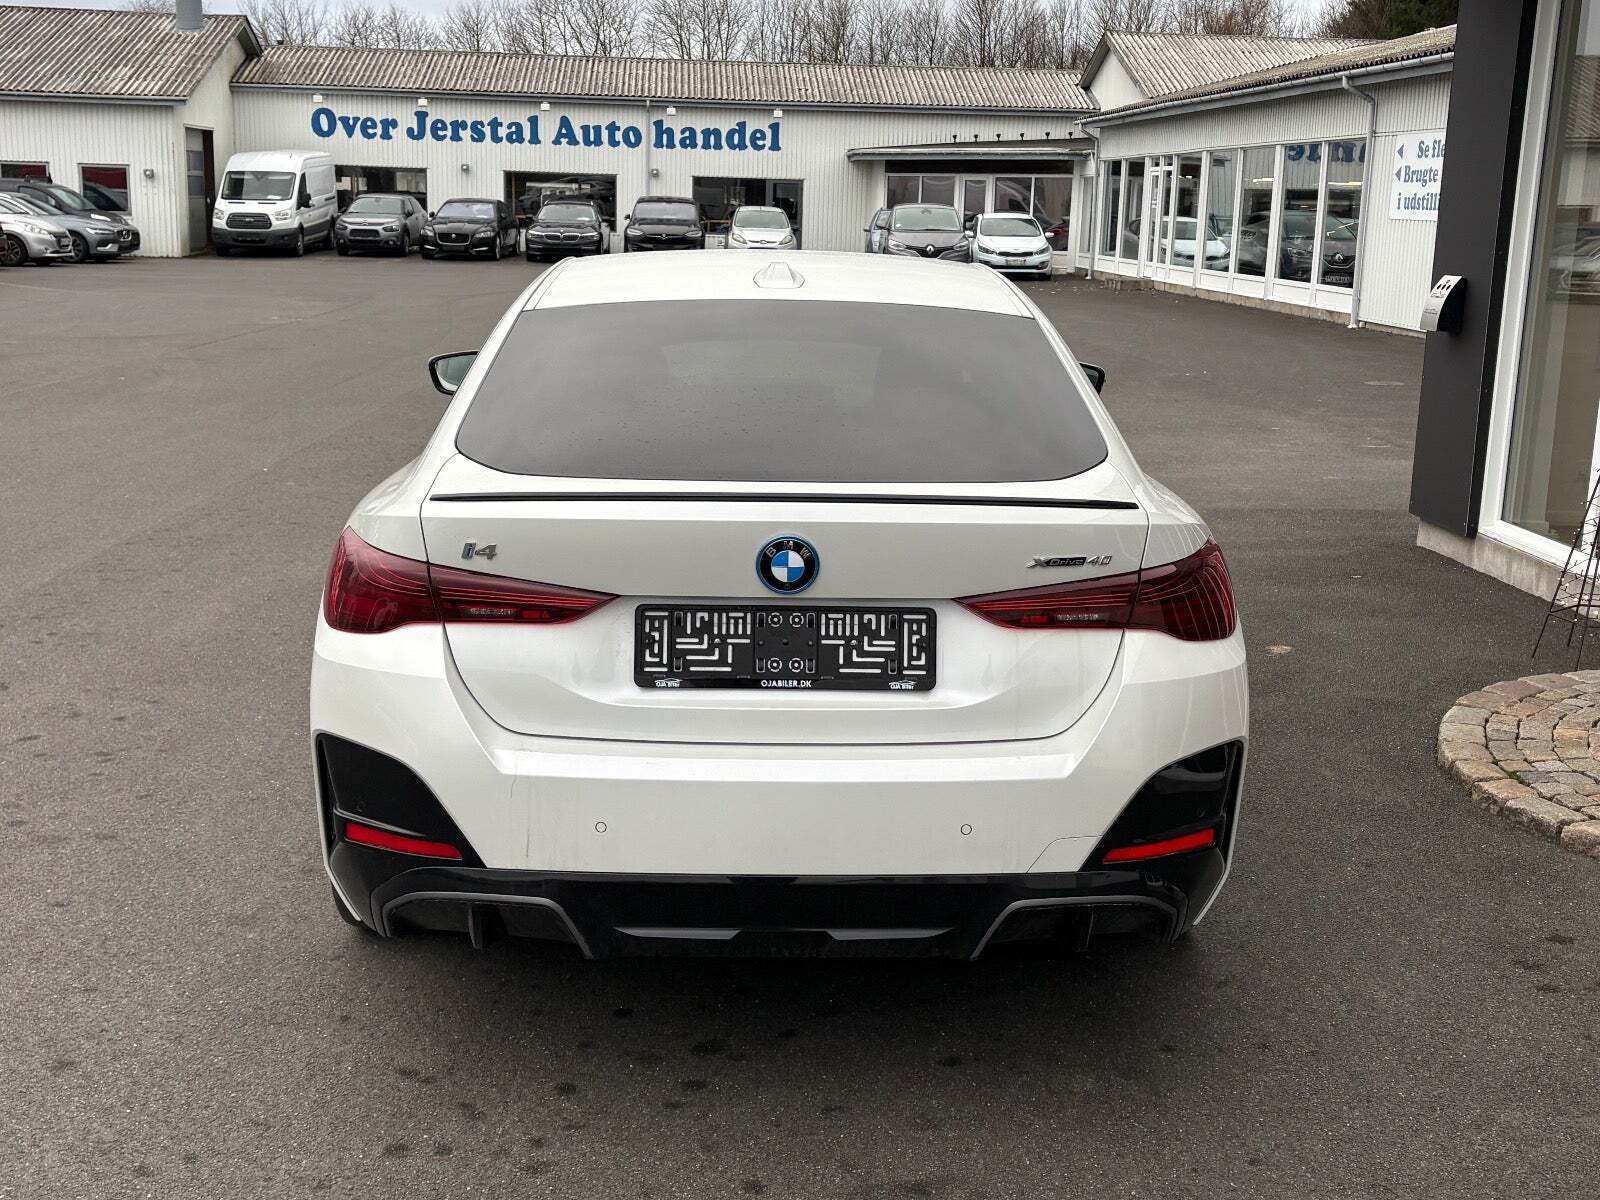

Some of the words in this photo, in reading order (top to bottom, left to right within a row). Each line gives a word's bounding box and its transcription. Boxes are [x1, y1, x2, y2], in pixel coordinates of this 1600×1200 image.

[311, 107, 399, 140] Over
[406, 110, 542, 145] Jerstal
[552, 115, 643, 149] Auto
[652, 119, 782, 151] handel
[1417, 140, 1430, 158] Se
[1403, 165, 1439, 187] Brugte
[1397, 192, 1402, 210] i
[461, 542, 498, 560] i4
[766, 540, 812, 558] BMW
[760, 679, 812, 688] OJABILER.DK
